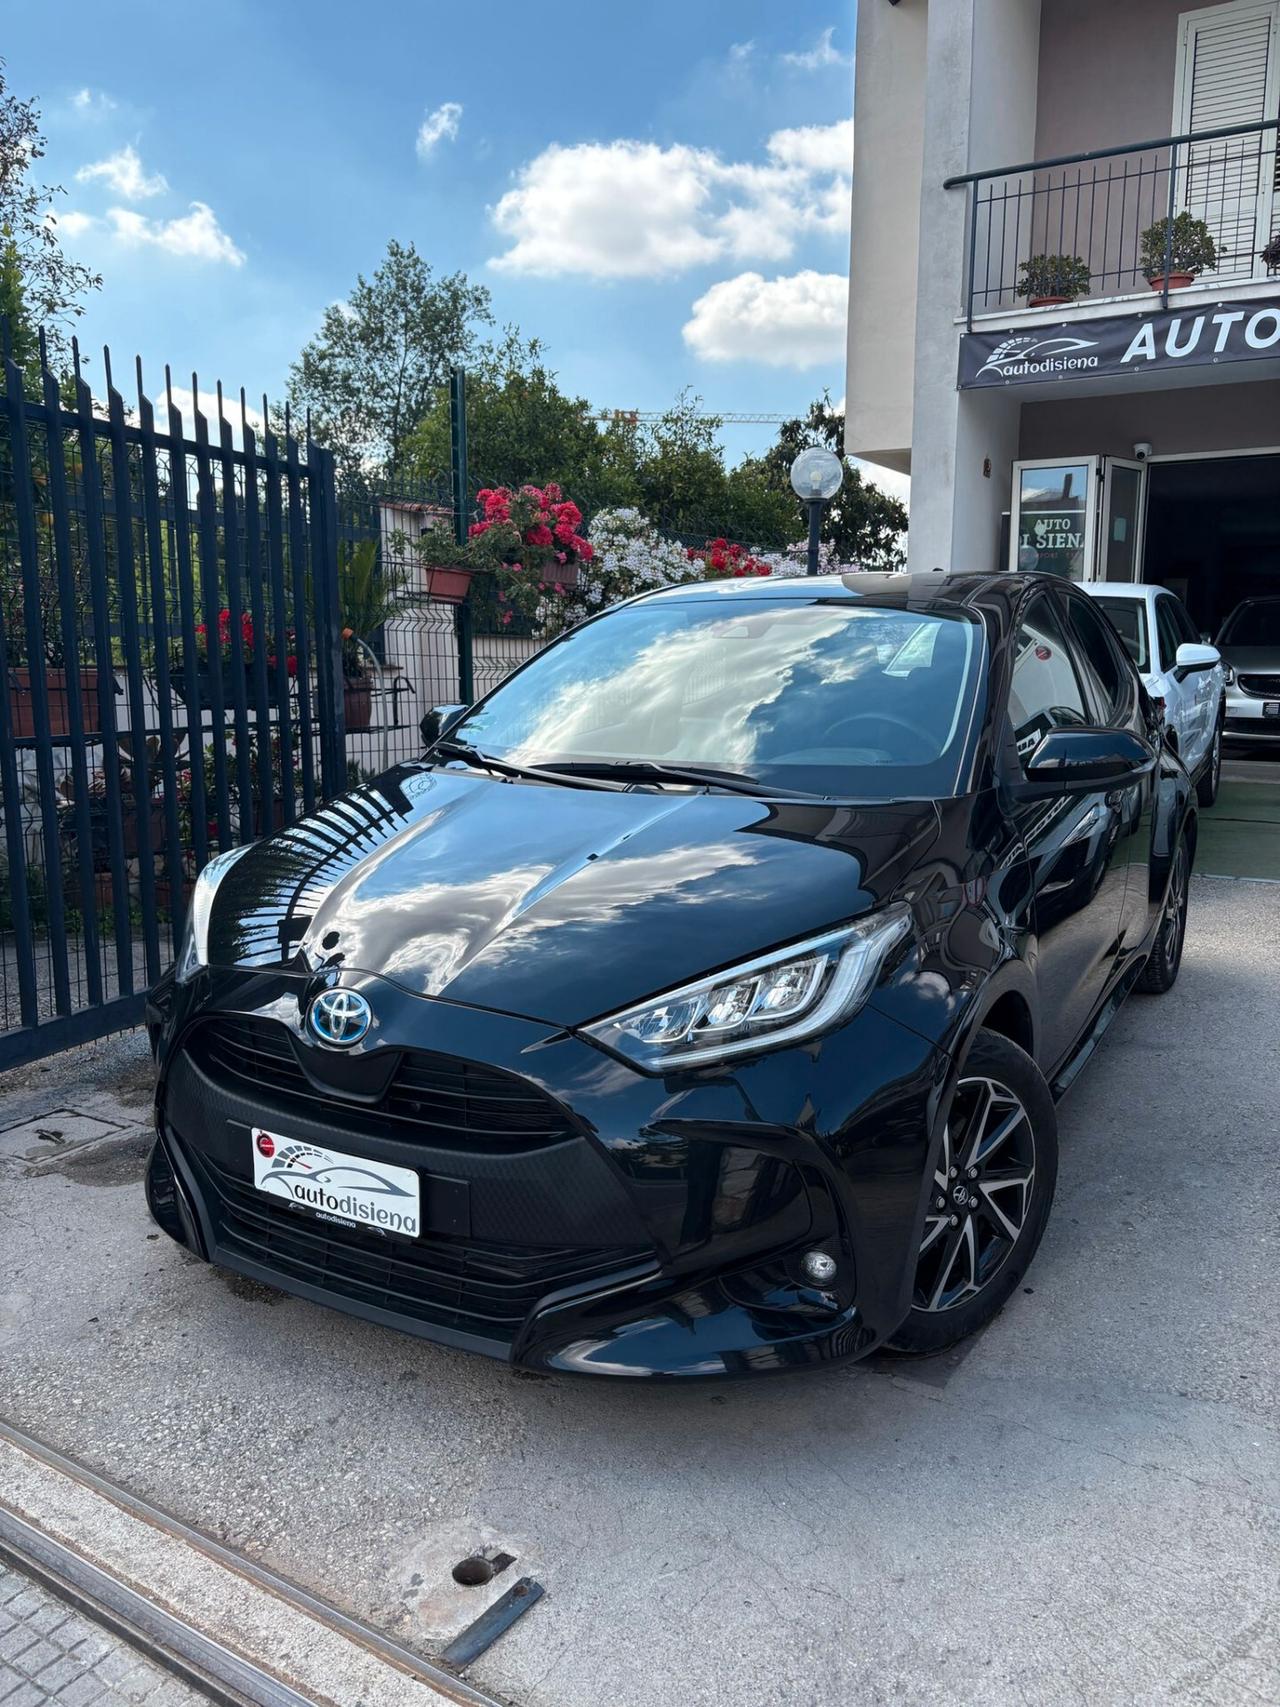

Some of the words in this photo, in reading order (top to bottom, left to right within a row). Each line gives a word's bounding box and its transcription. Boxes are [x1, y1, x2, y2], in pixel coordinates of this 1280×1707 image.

[1120, 308, 1280, 363] AUTO
[1003, 356, 1099, 376] autodisiena
[1036, 532, 1084, 549] SIEN
[294, 1184, 417, 1233] autodisiena
[315, 1211, 357, 1229] autodisiena
